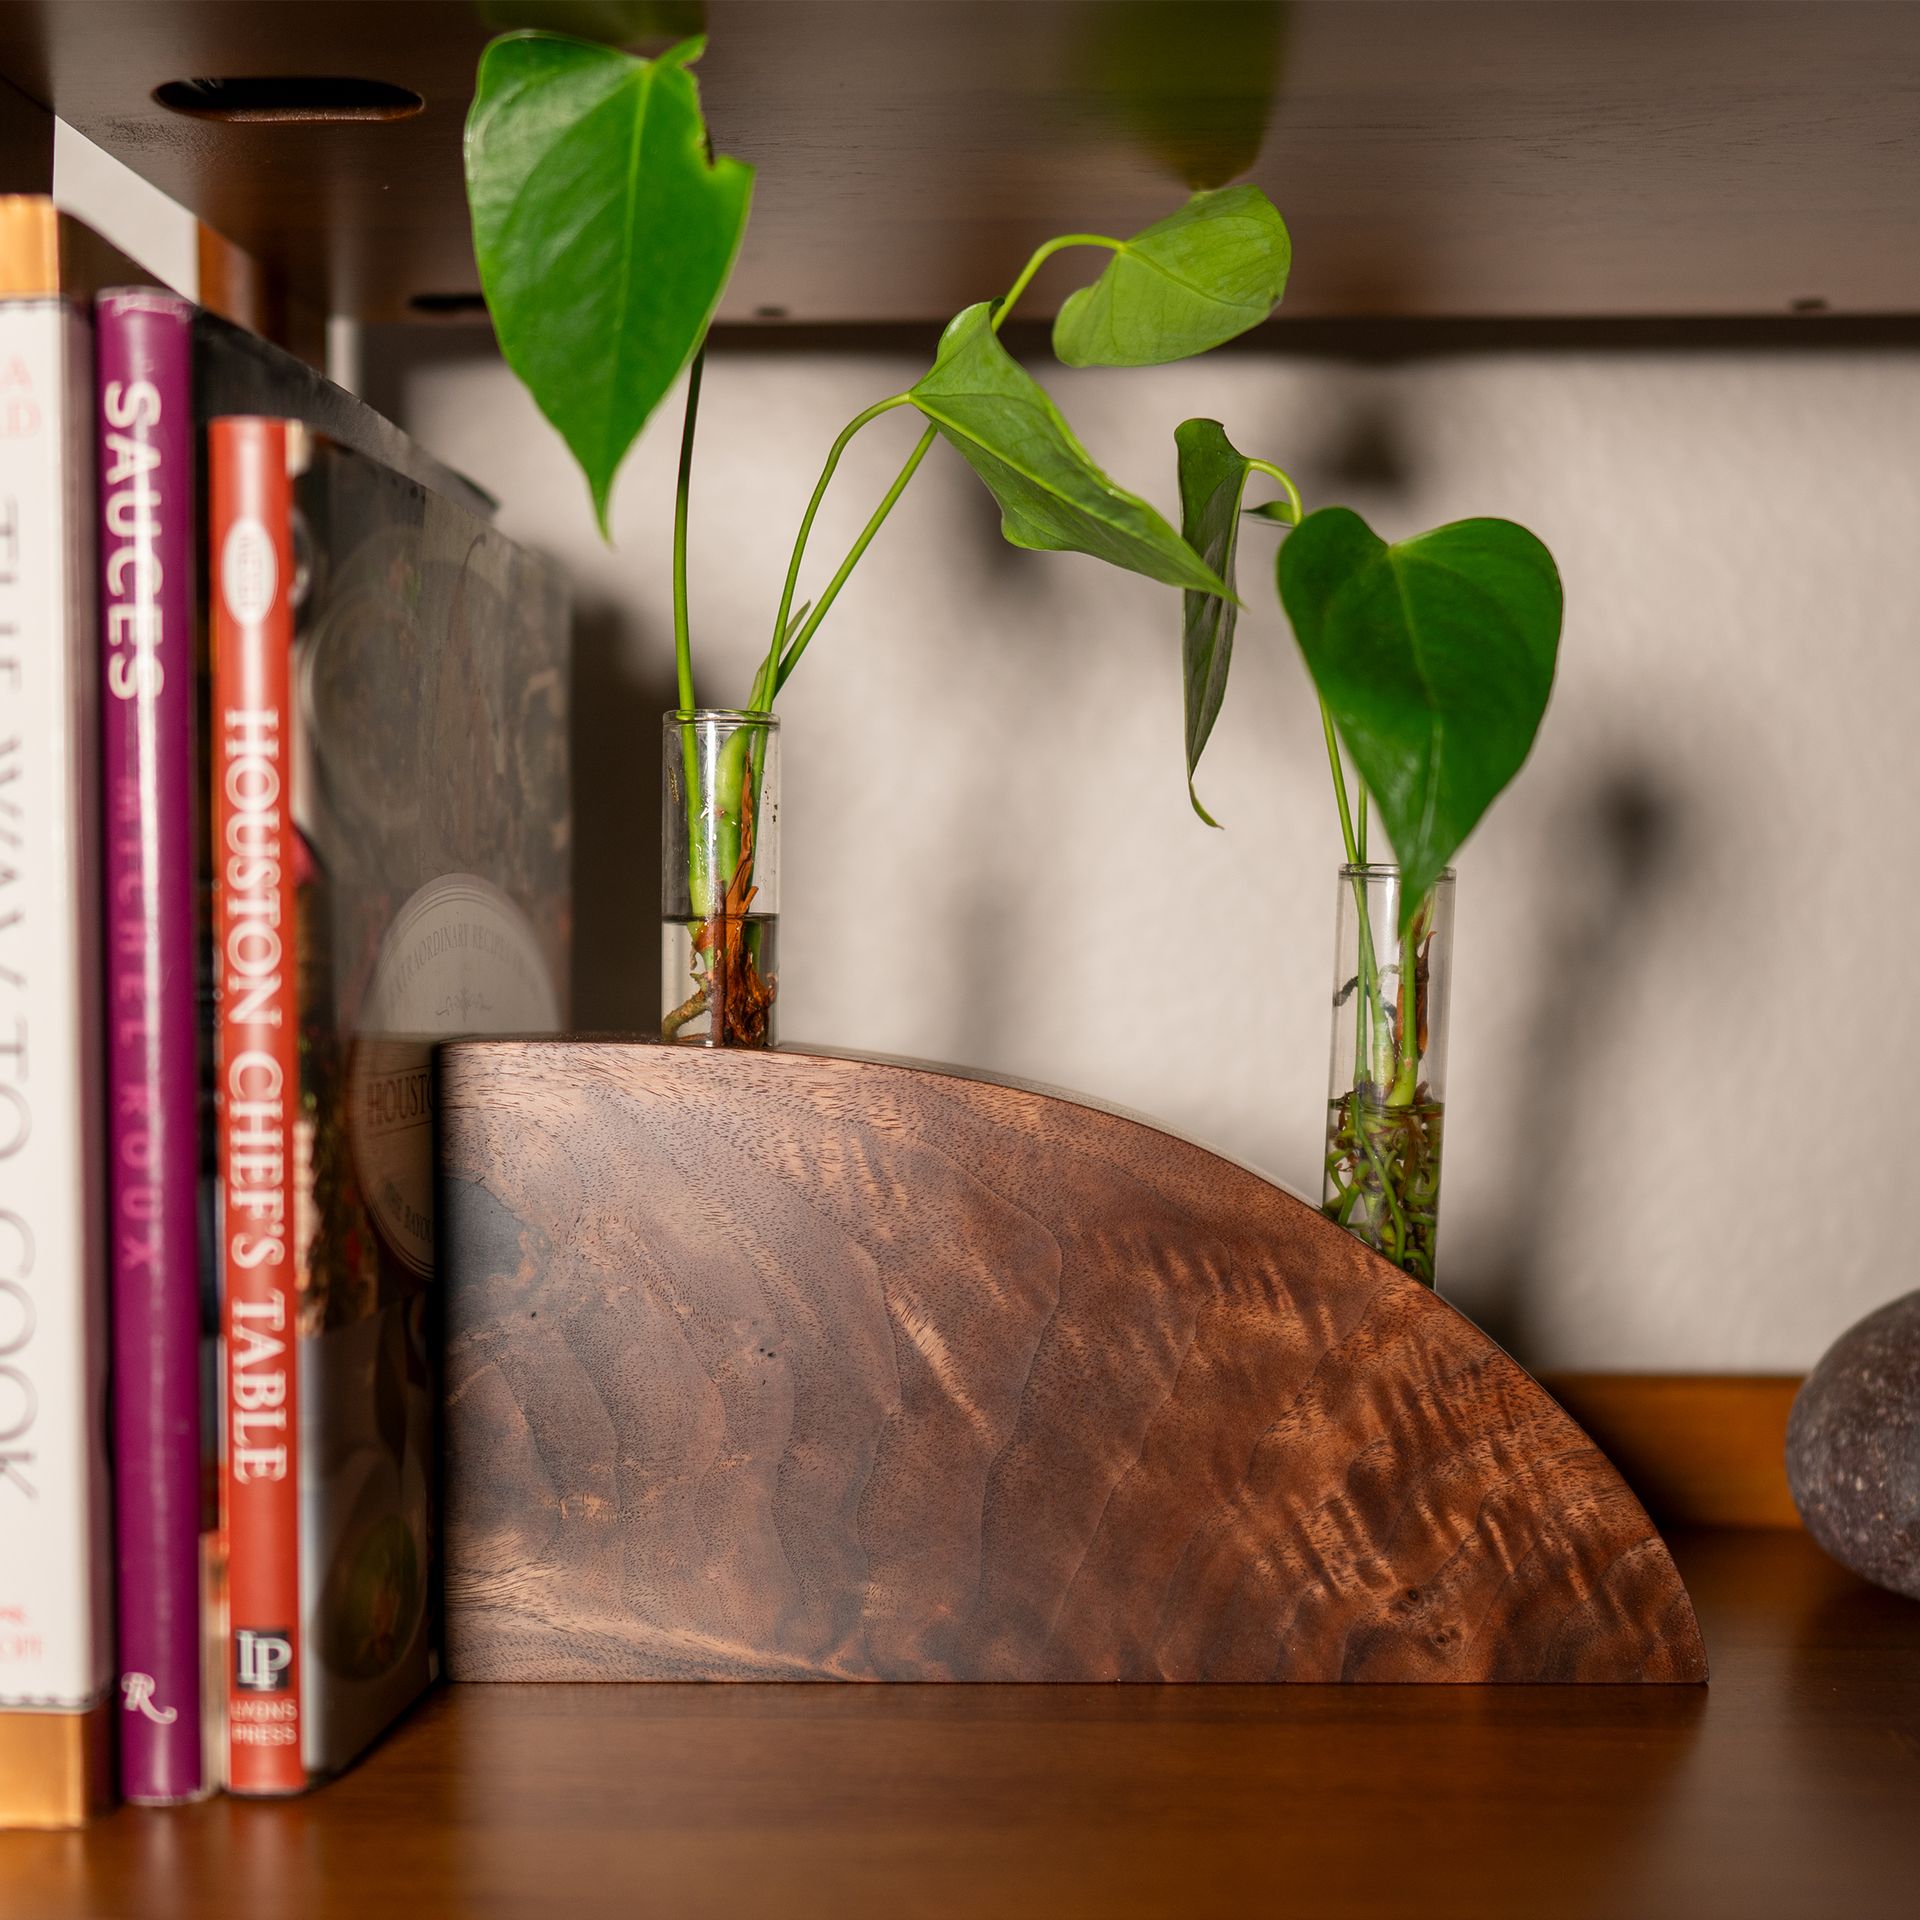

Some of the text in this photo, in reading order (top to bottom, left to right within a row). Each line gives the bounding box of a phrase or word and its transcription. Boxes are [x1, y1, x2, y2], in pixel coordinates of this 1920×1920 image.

[104, 379, 164, 700] SAUCES
[114, 777, 163, 1273] MICHEL ROUX
[225, 707, 287, 1485] HOUSTON CHEF'S TABLE
[367, 1072, 433, 1128] HOUST
[232, 1723, 297, 1746] PRESS
